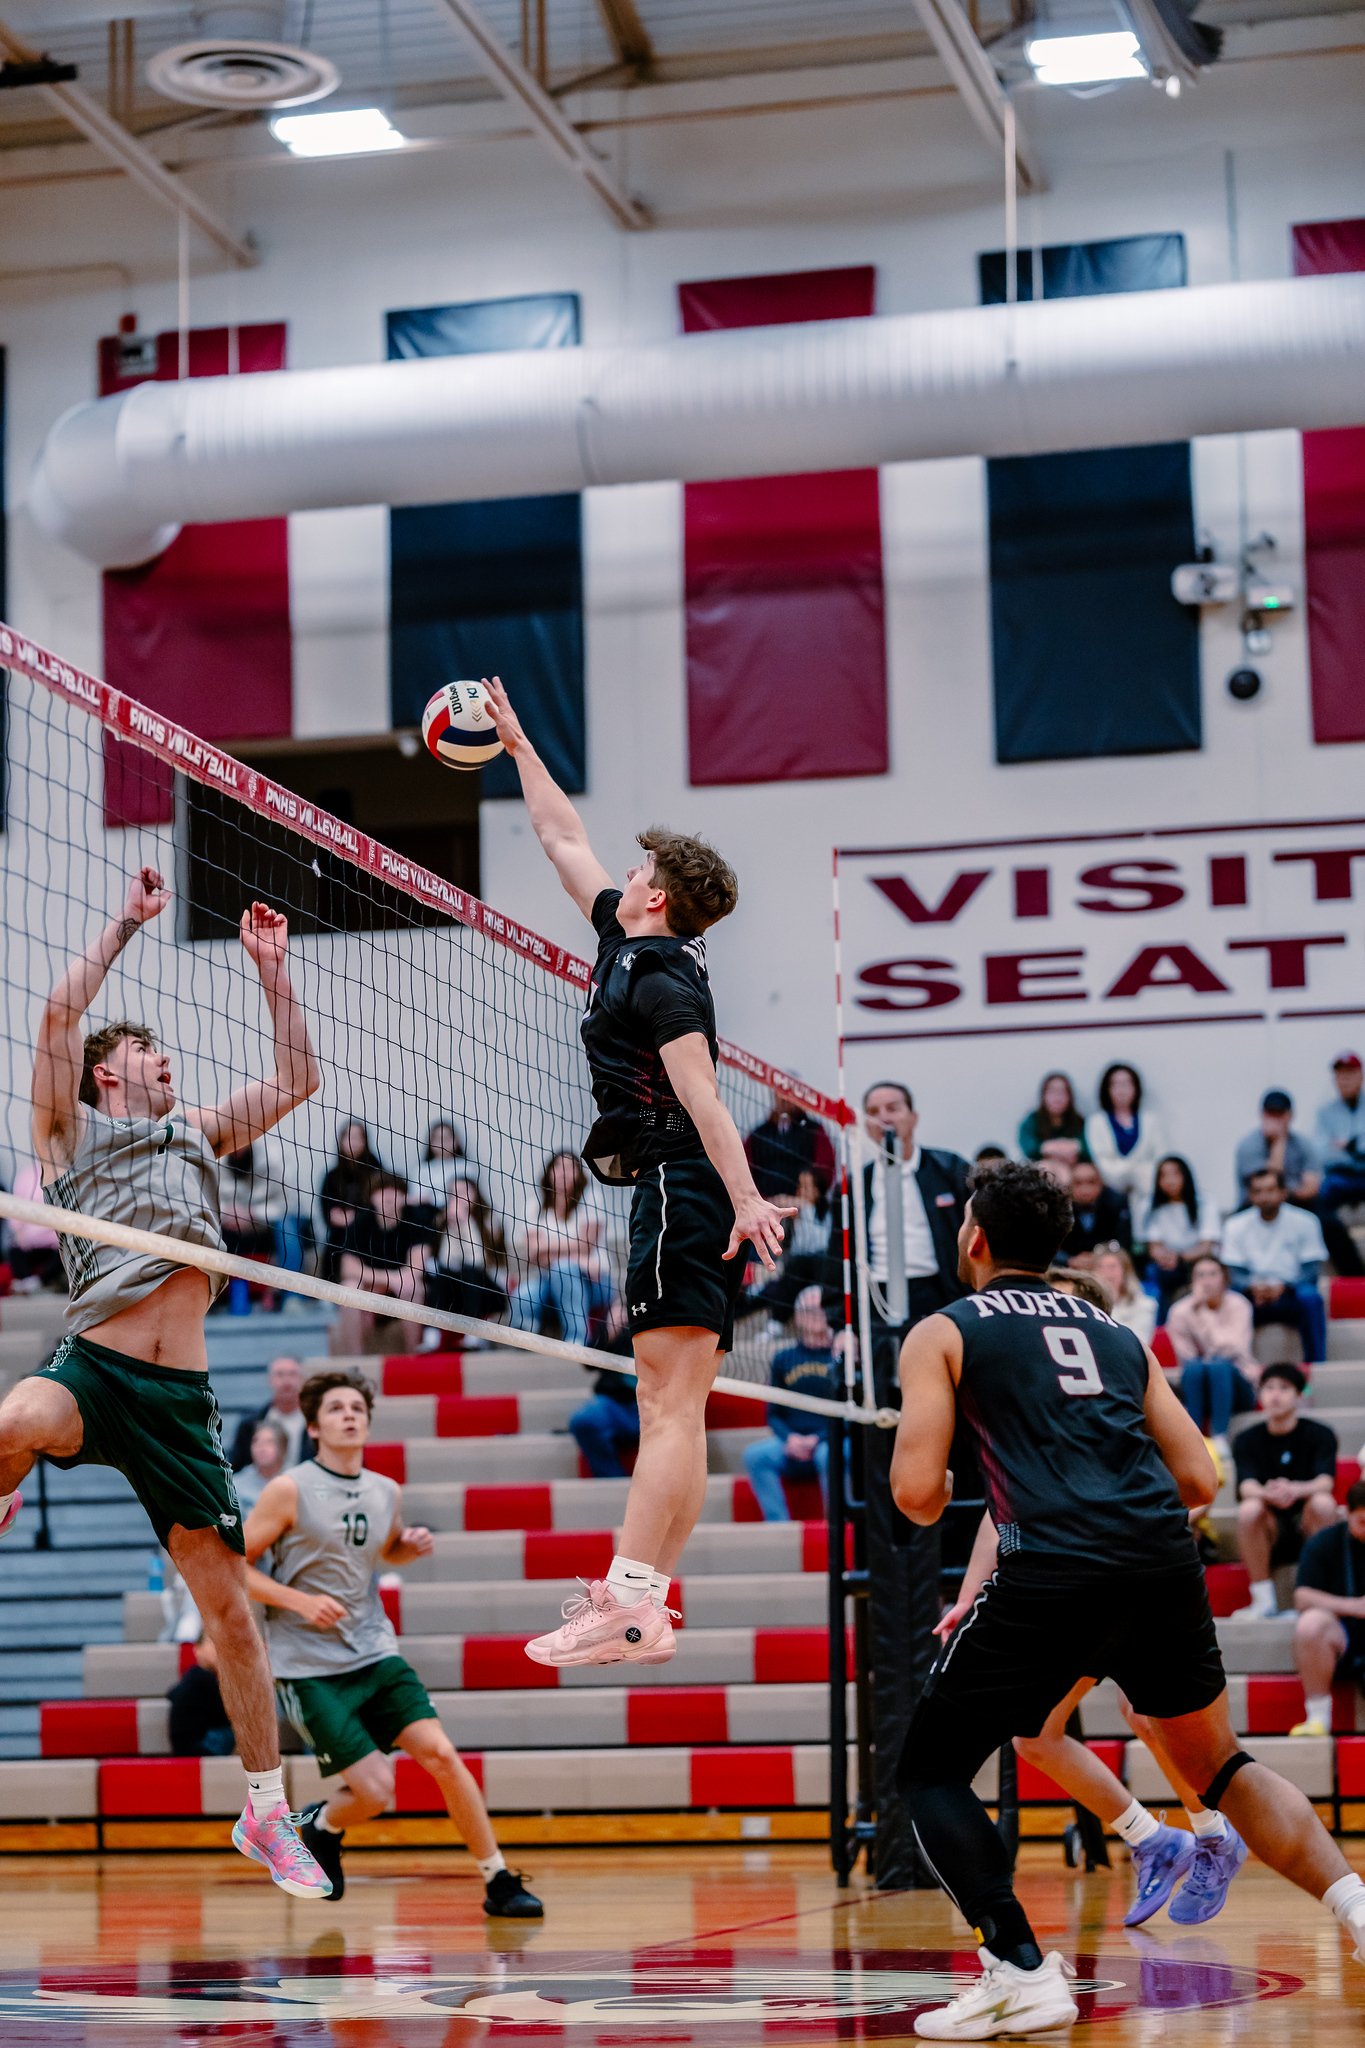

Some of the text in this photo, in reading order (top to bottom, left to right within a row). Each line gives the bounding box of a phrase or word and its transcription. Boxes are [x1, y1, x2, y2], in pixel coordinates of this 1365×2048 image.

[449, 684, 463, 715] Wilson
[130, 707, 165, 745] PNHS
[168, 728, 238, 788] VOLLEYBALL
[265, 785, 297, 819] PNHS
[300, 803, 359, 854] VOLLEYBALL
[381, 853, 409, 881] PNHS
[852, 934, 1347, 1011] SEAT
[1042, 1325, 1104, 1395] 9
[342, 1512, 368, 1547] 10
